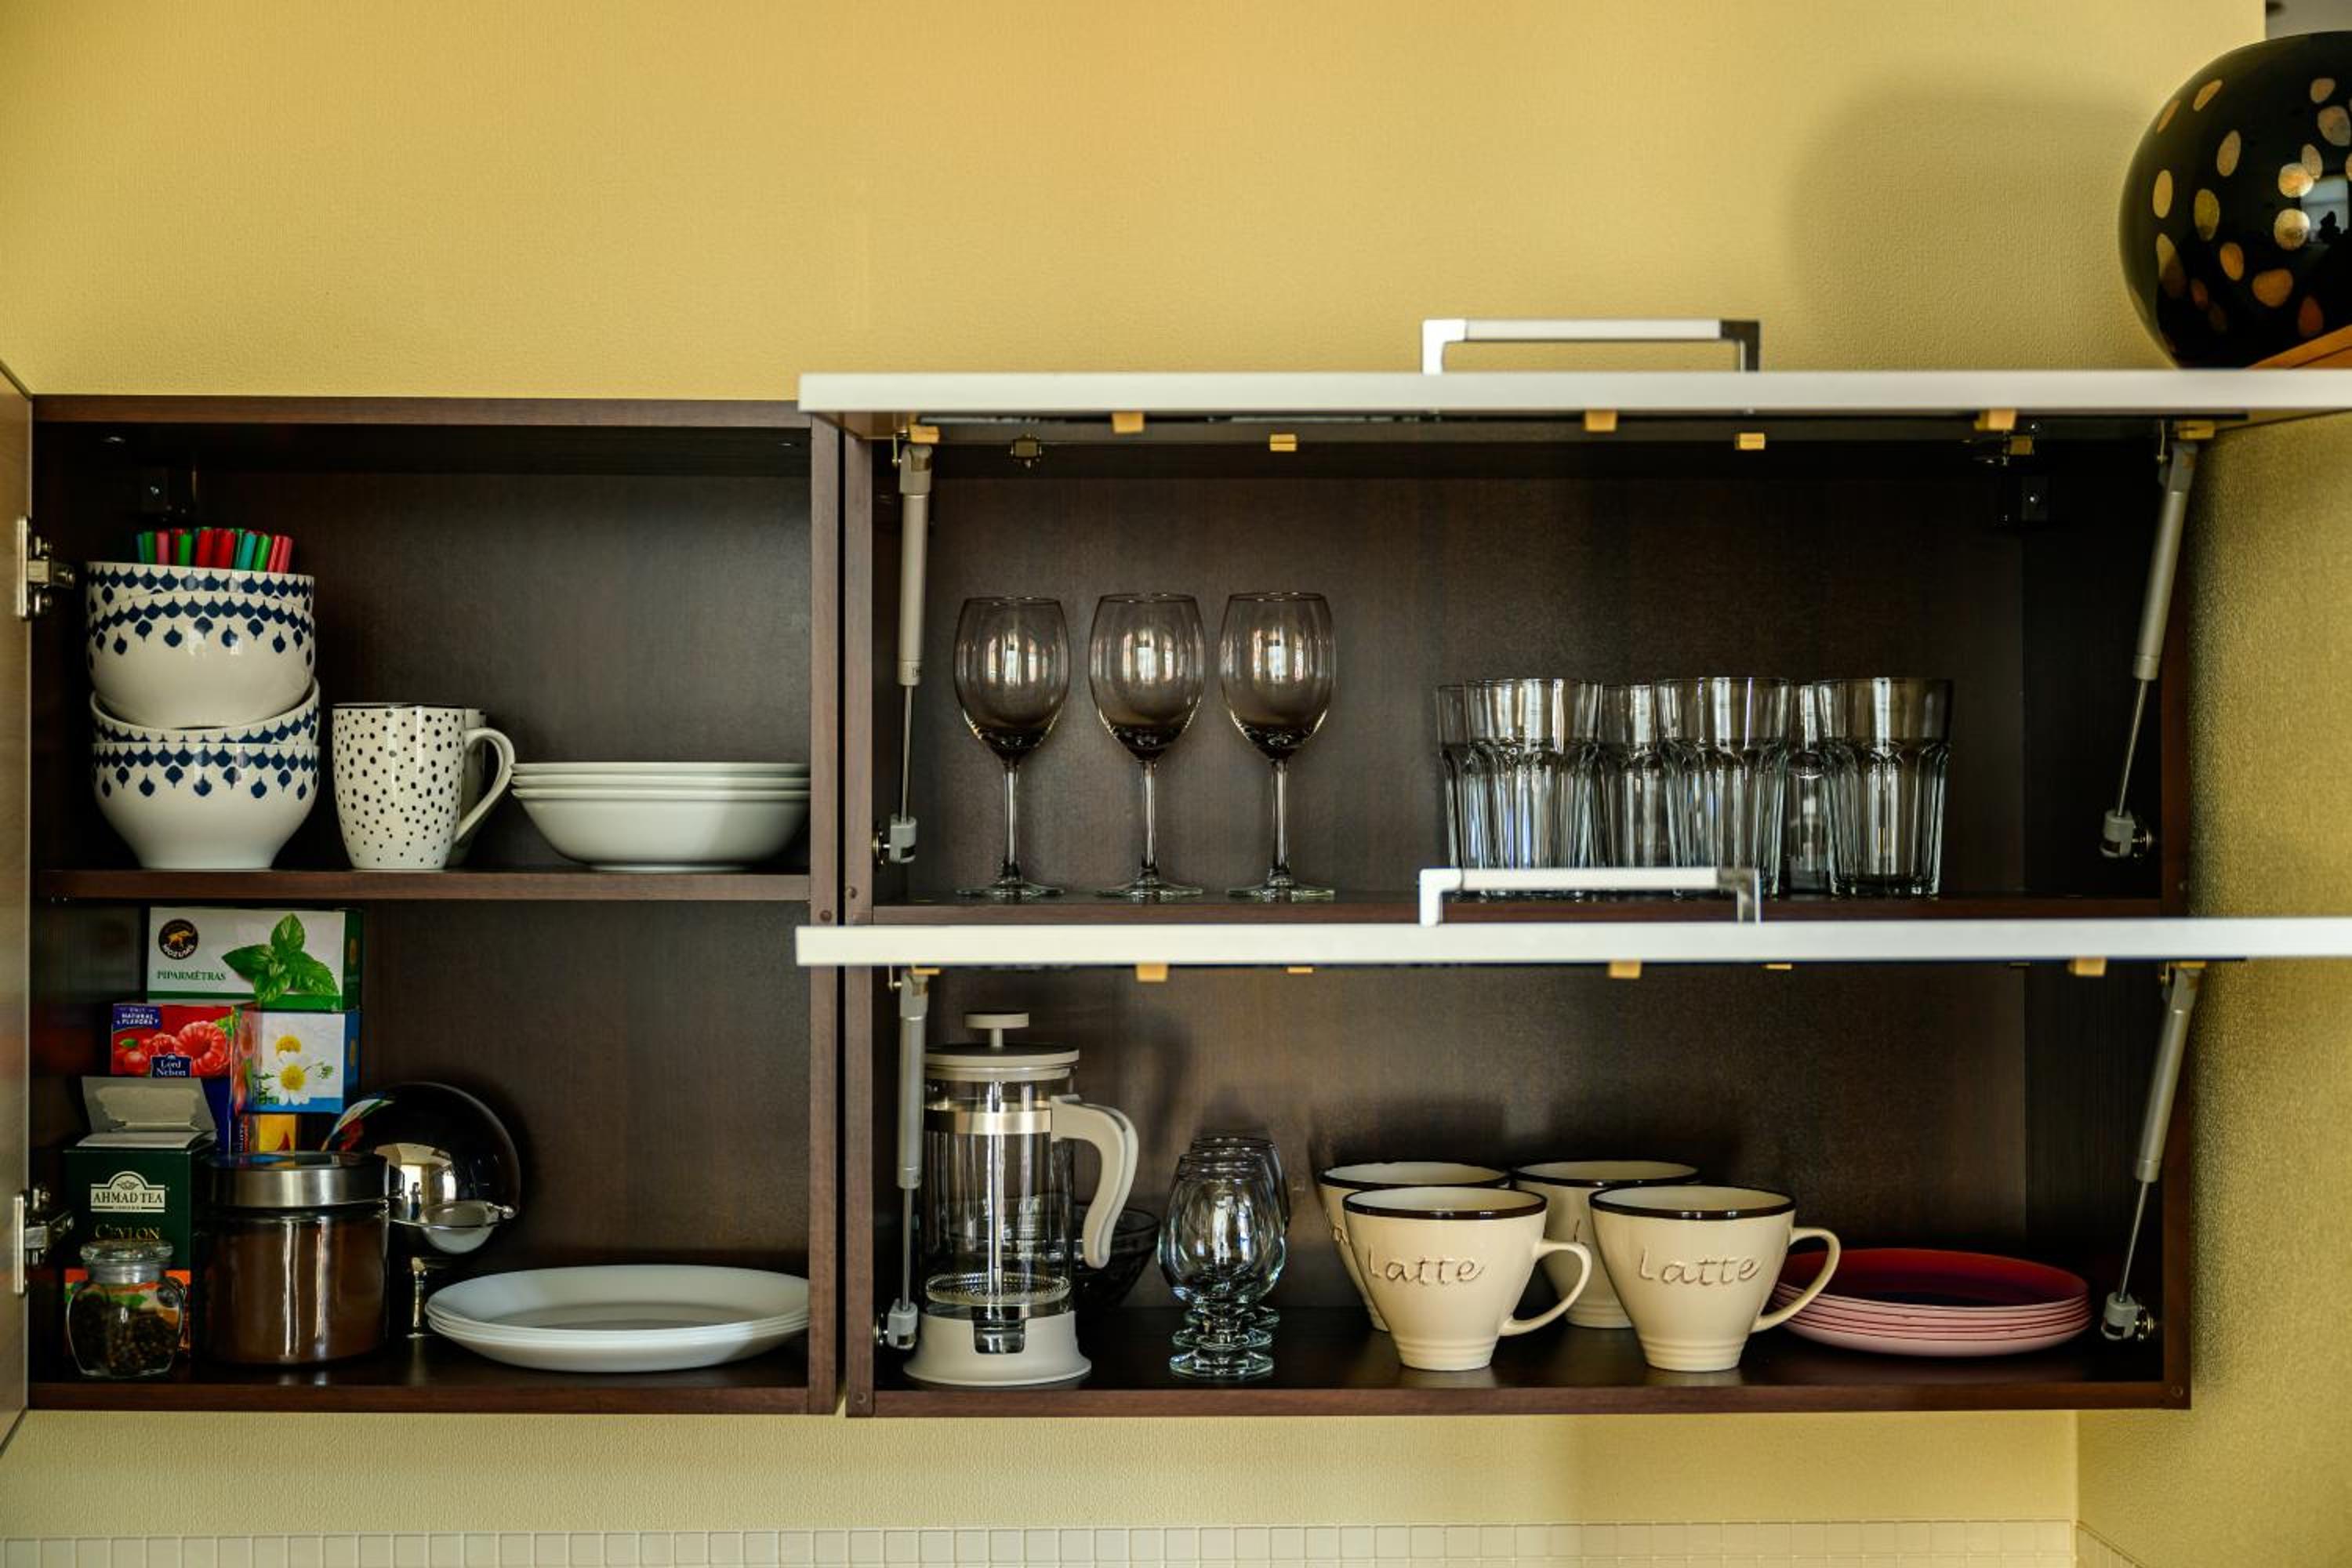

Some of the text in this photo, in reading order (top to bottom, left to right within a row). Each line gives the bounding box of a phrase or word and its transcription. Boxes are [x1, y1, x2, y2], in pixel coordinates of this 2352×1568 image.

[161, 1059, 181, 1069] Lord
[157, 1067, 187, 1076] Nelson
[93, 1191, 163, 1203] AHMAD TEA
[1367, 1245, 1485, 1286] Latte
[1639, 1247, 1761, 1286] Latte
